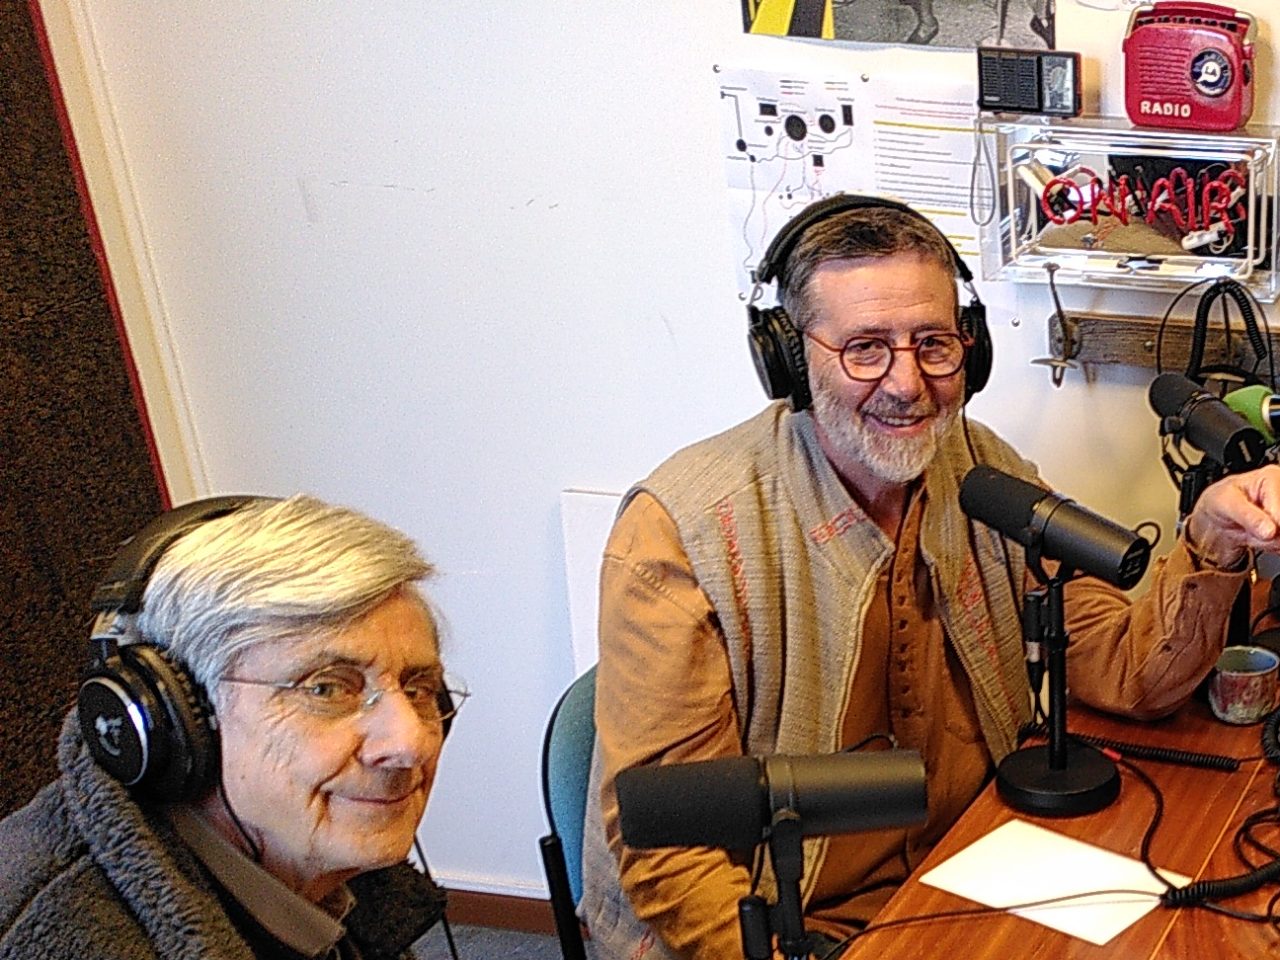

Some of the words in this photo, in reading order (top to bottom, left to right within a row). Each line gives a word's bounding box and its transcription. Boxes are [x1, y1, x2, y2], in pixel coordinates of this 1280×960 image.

[1140, 100, 1191, 118] RADIO
[1042, 175, 1129, 225] ON
[1145, 177, 1236, 236] AIR
